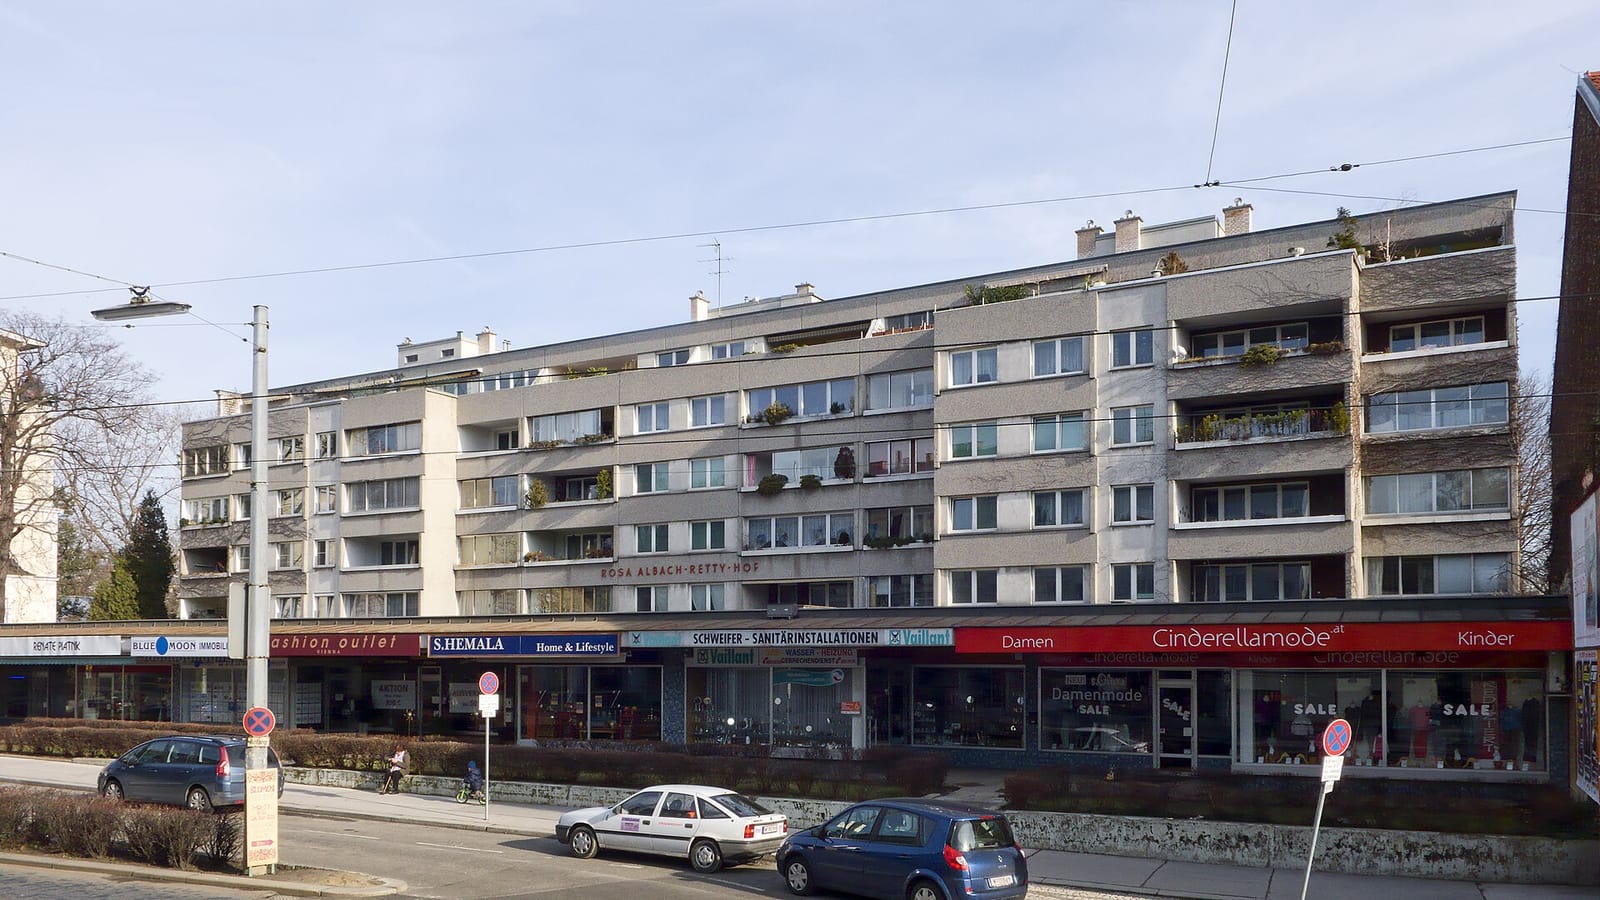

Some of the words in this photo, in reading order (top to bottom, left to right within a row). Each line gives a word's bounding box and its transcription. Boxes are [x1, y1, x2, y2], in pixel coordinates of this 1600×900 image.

[601, 567, 632, 578] ROSA
[271, 635, 330, 649] ashion
[339, 634, 397, 649] outlet
[433, 637, 504, 651] S.HEMALA
[693, 632, 743, 645] SCHWEIFER
[752, 630, 879, 645] SANITÄRINSTALLATIONEN
[902, 629, 950, 646] Vaillant
[1002, 635, 1054, 648] Damen
[1458, 631, 1515, 646] Kinder
[132, 641, 156, 650] BLUE
[168, 641, 197, 650] MOON
[536, 642, 563, 652] Home
[565, 642, 573, 652] &
[575, 641, 615, 654] Lifestyle
[785, 648, 815, 656] WASSER
[711, 649, 754, 665] Vaillant
[1052, 687, 1142, 701] Damenmode
[1079, 704, 1110, 715] SALE
[1163, 698, 1190, 721] SALE
[1293, 703, 1337, 716] SALE
[1443, 703, 1490, 716] SALE
